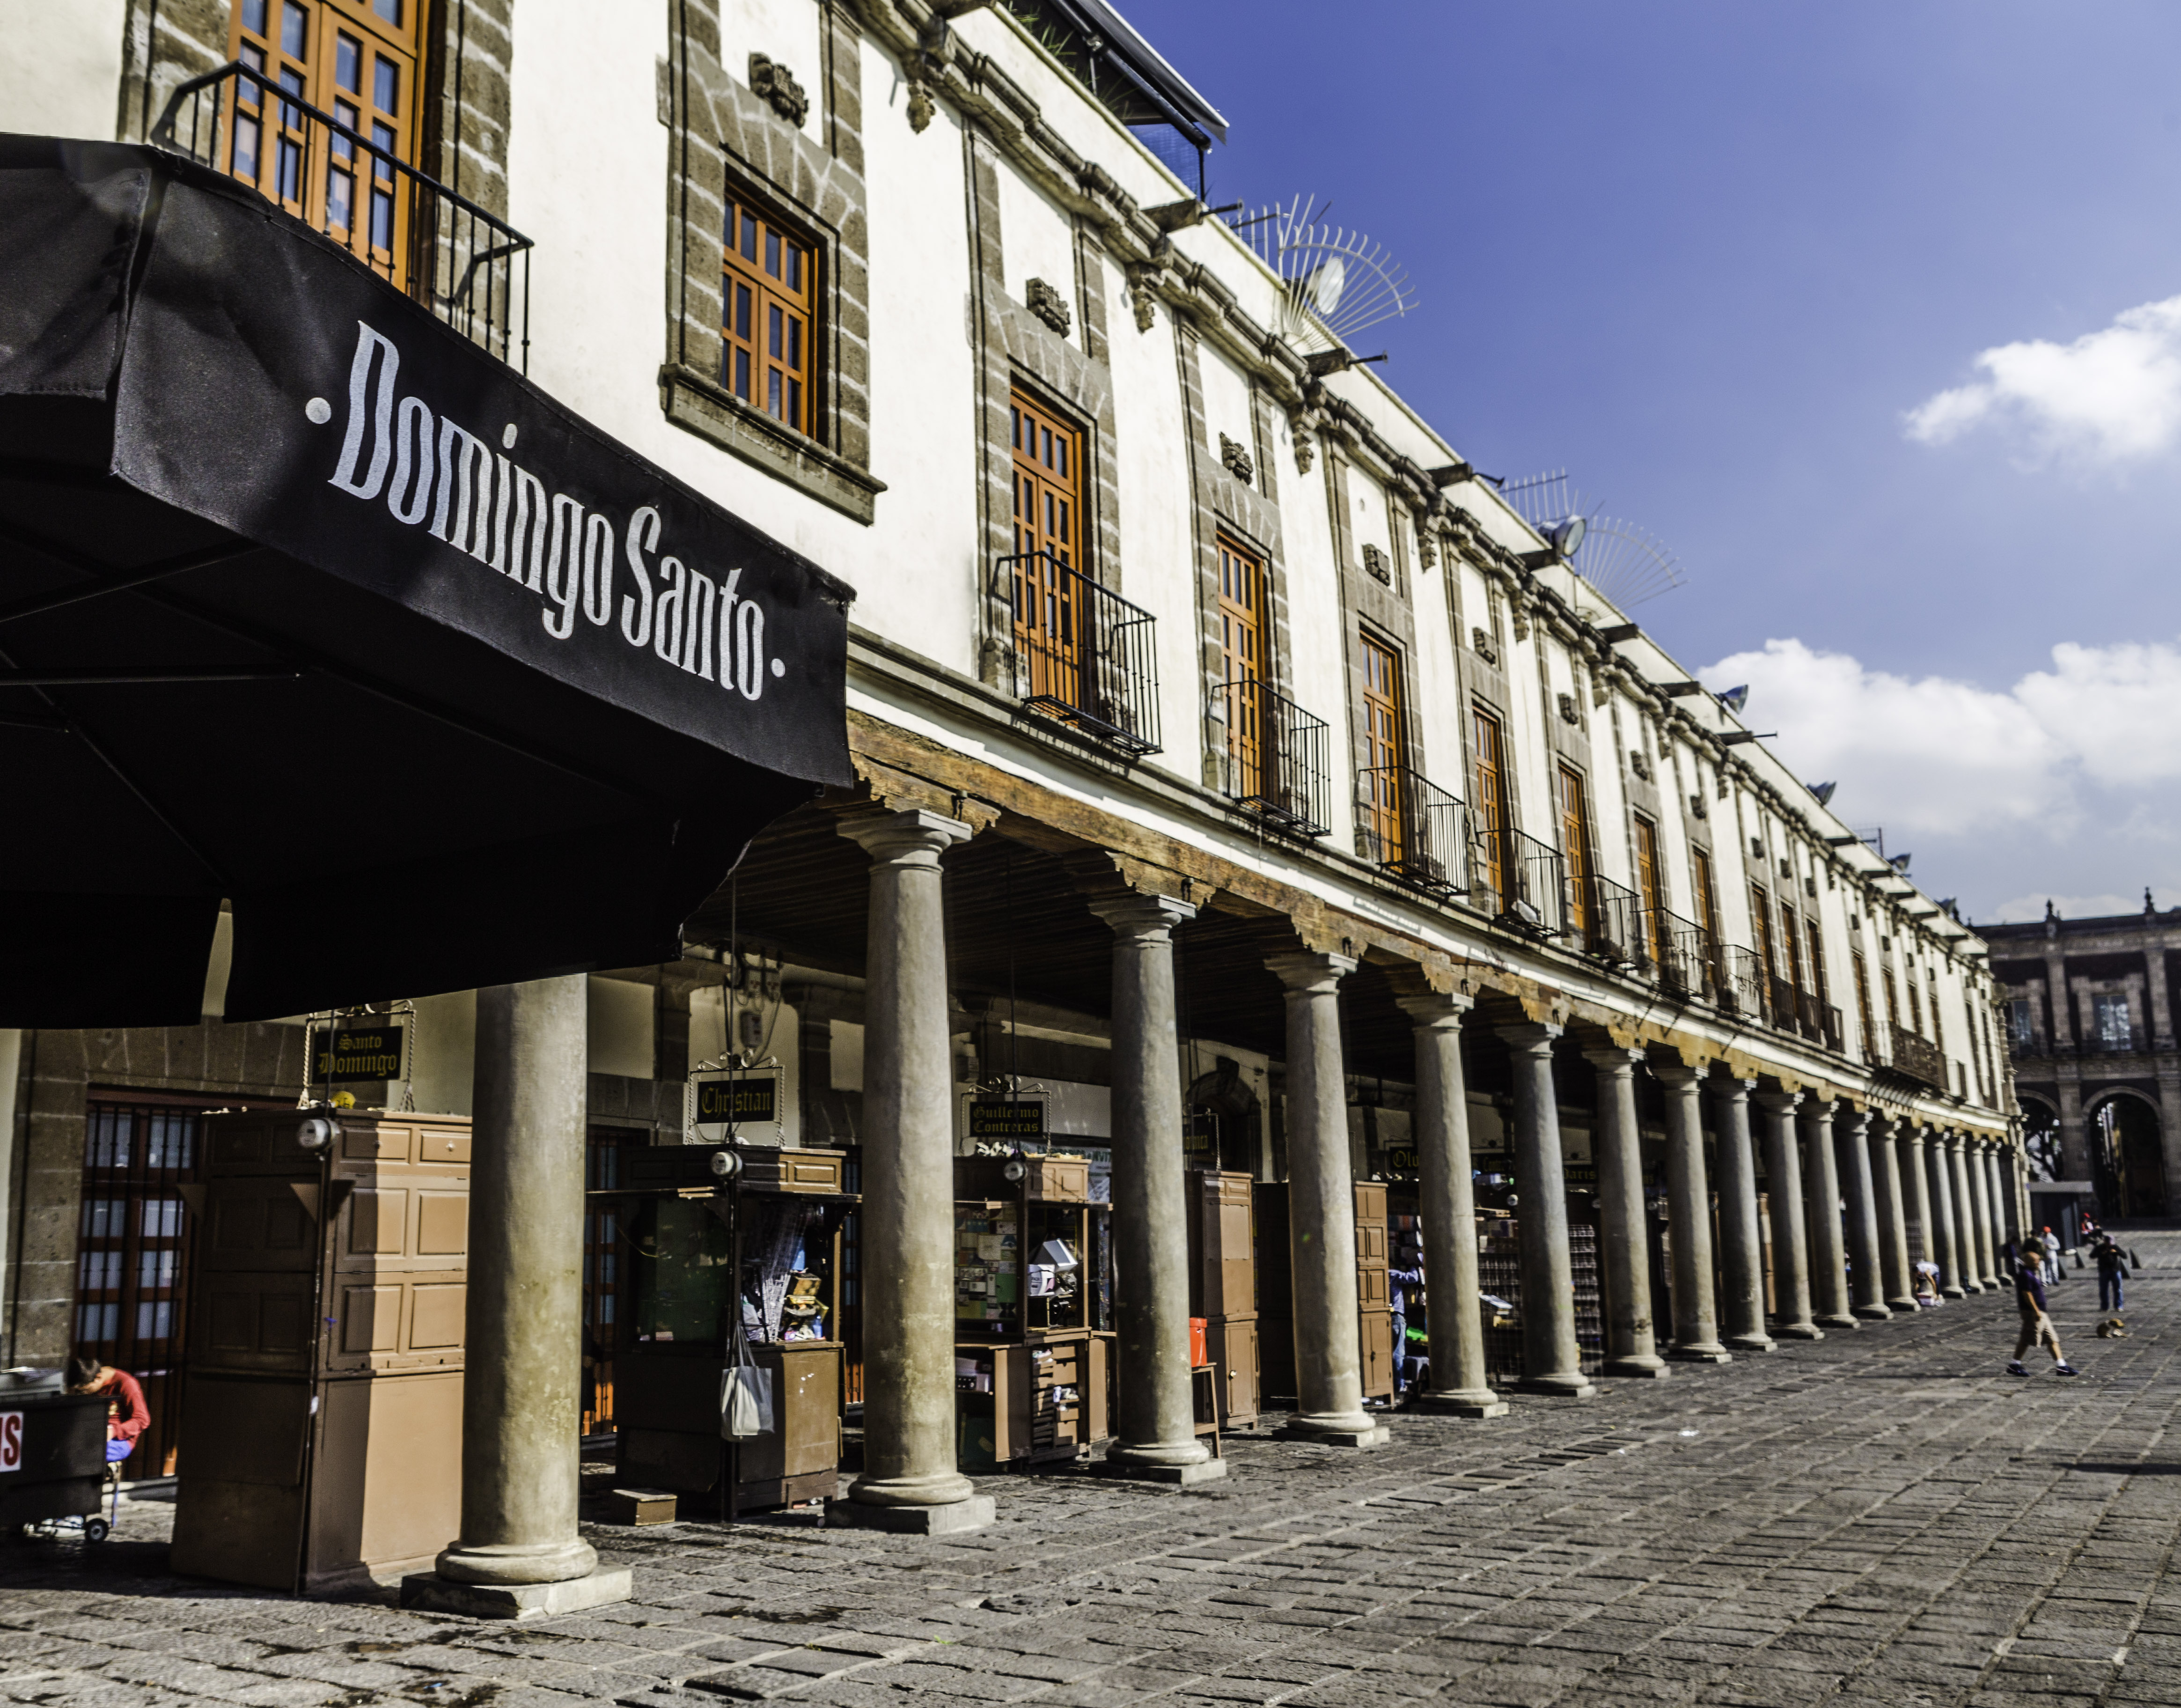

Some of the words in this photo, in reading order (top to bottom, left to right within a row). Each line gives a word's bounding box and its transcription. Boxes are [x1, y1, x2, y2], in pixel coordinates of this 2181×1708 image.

[328, 320, 615, 640] Domingo
[621, 506, 764, 701] Santo
[338, 1033, 382, 1052] Santo
[318, 1053, 397, 1076] Domingo
[701, 1086, 771, 1119] Chrstian
[973, 1105, 1039, 1118] Guillemo
[0, 1414, 20, 1466] S
